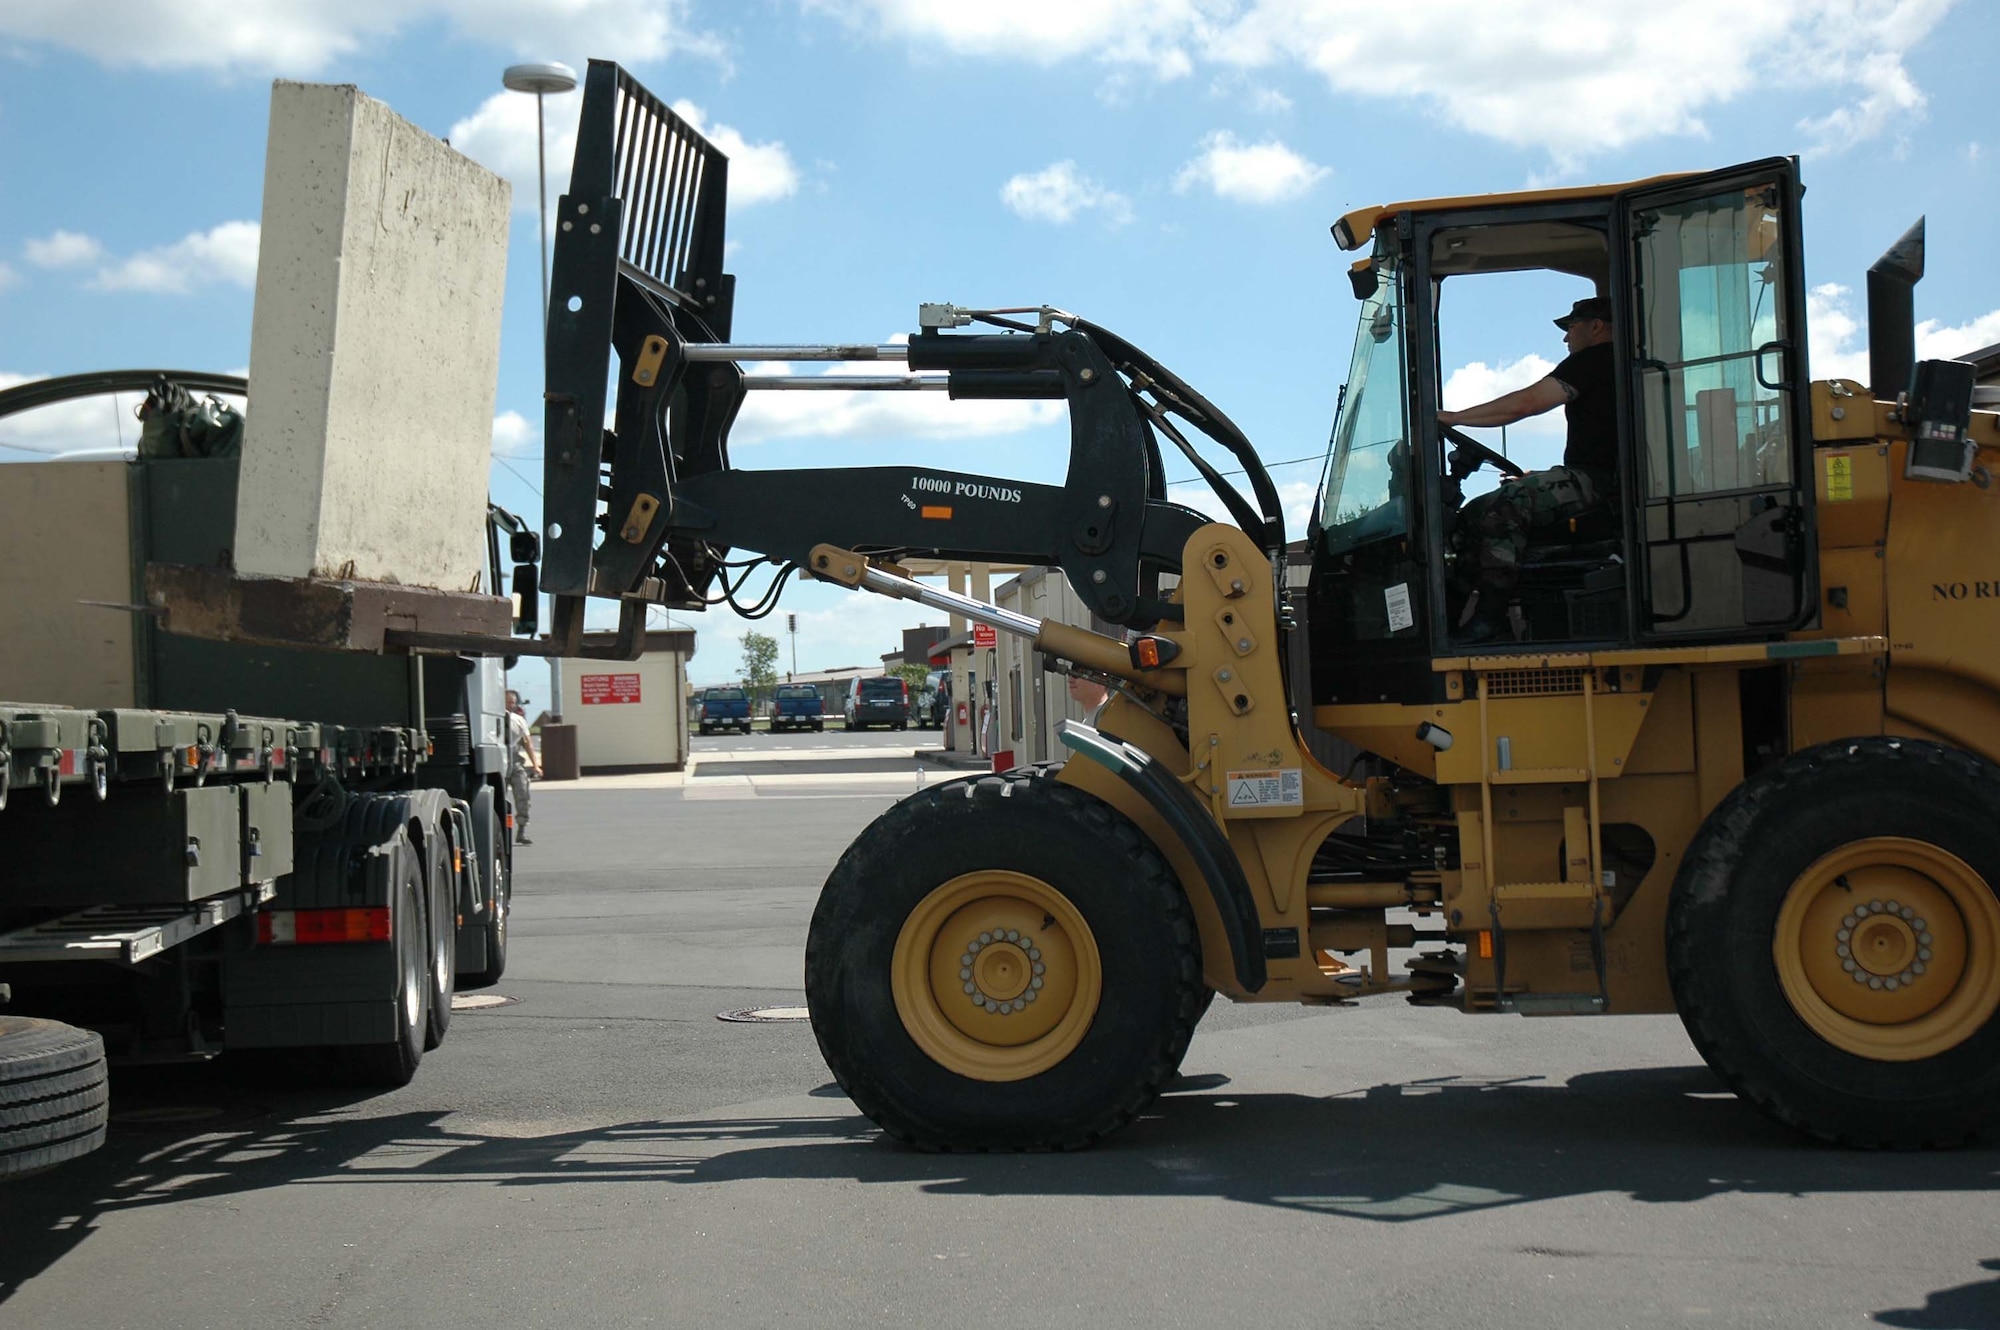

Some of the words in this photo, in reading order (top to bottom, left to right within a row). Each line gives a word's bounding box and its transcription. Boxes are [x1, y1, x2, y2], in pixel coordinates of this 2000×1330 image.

[911, 476, 952, 494] 10000
[954, 481, 1022, 504] POUNDS
[1931, 583, 1968, 601] NO
